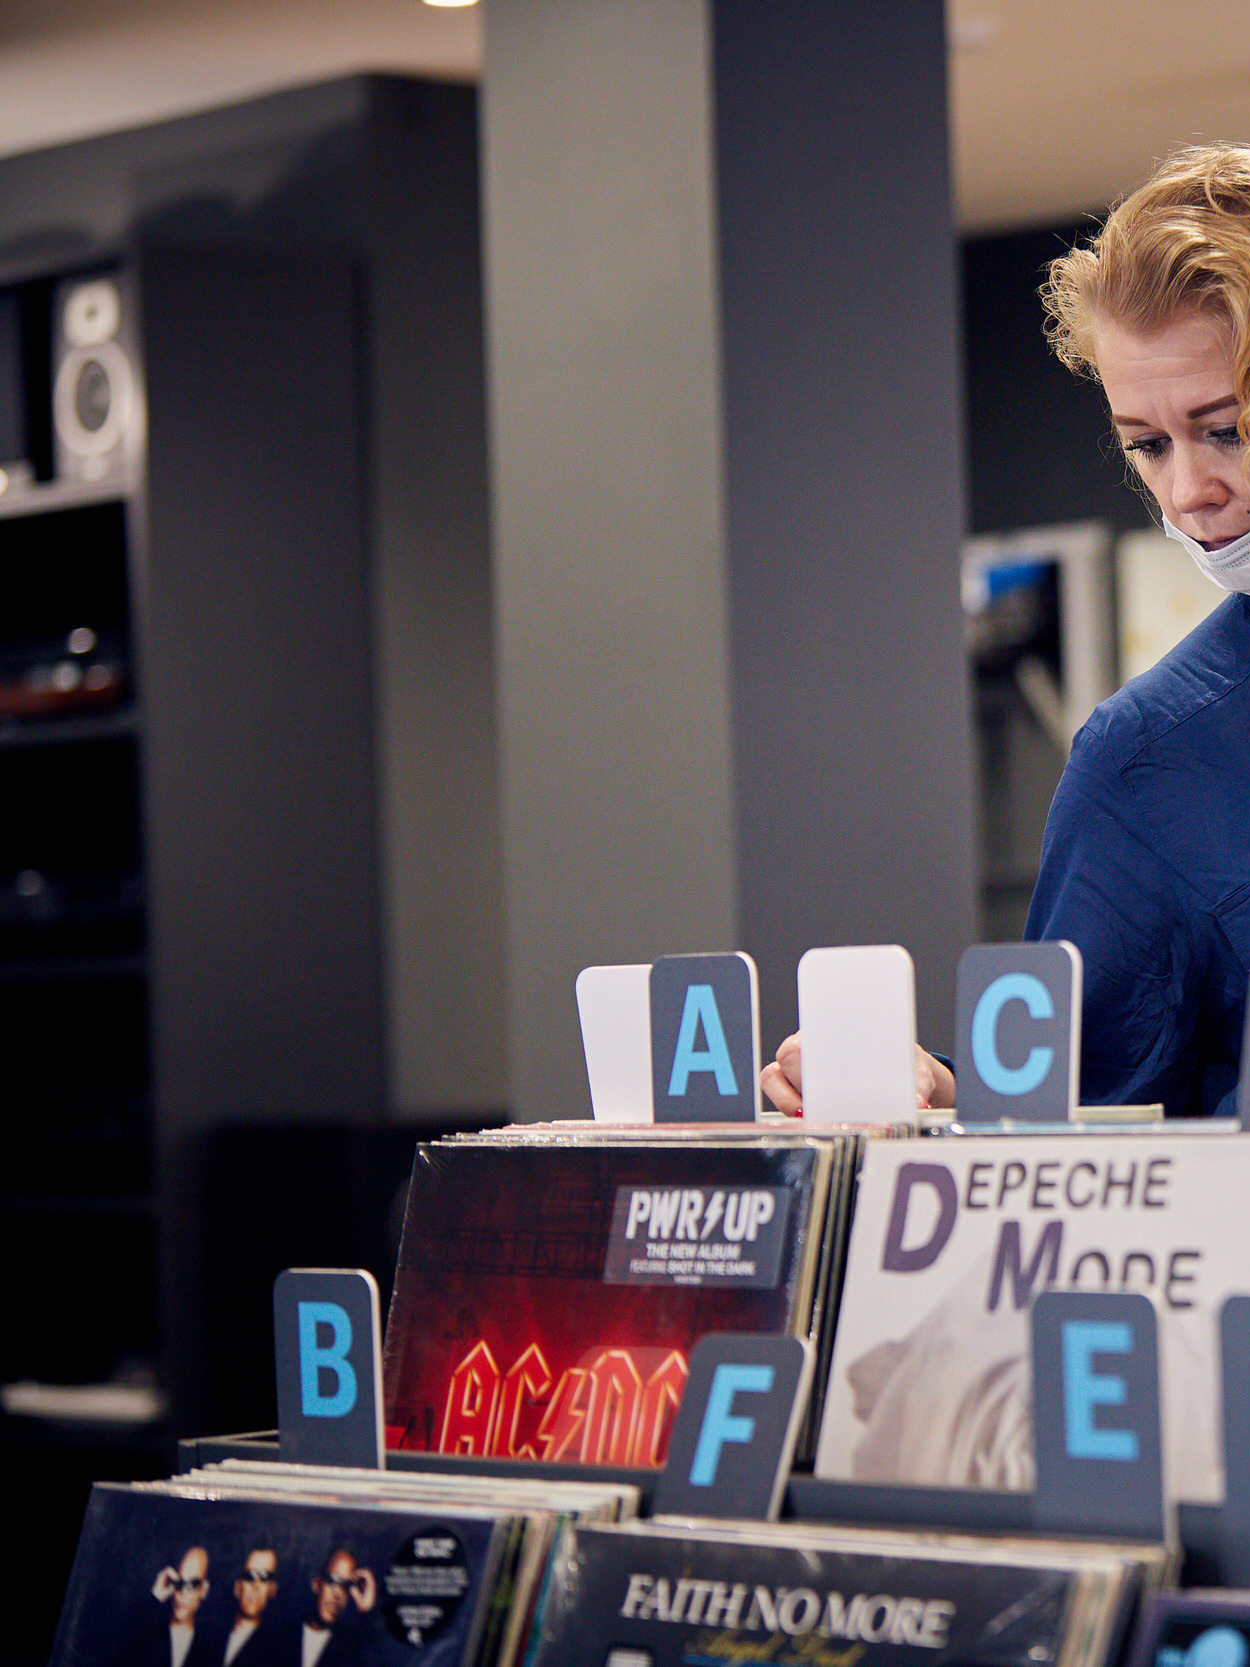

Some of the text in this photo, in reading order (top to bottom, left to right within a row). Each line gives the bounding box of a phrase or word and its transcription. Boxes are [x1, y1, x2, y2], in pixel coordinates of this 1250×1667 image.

[668, 984, 739, 1097] A
[971, 972, 1055, 1097] C
[646, 1242, 741, 1260] THE NEW ALBUM
[880, 1157, 1172, 1273] DEPECHE
[298, 1301, 358, 1418] B
[1061, 1321, 1139, 1461] E
[688, 1364, 775, 1488] F
[620, 1573, 957, 1649] FAITH NO MORE
